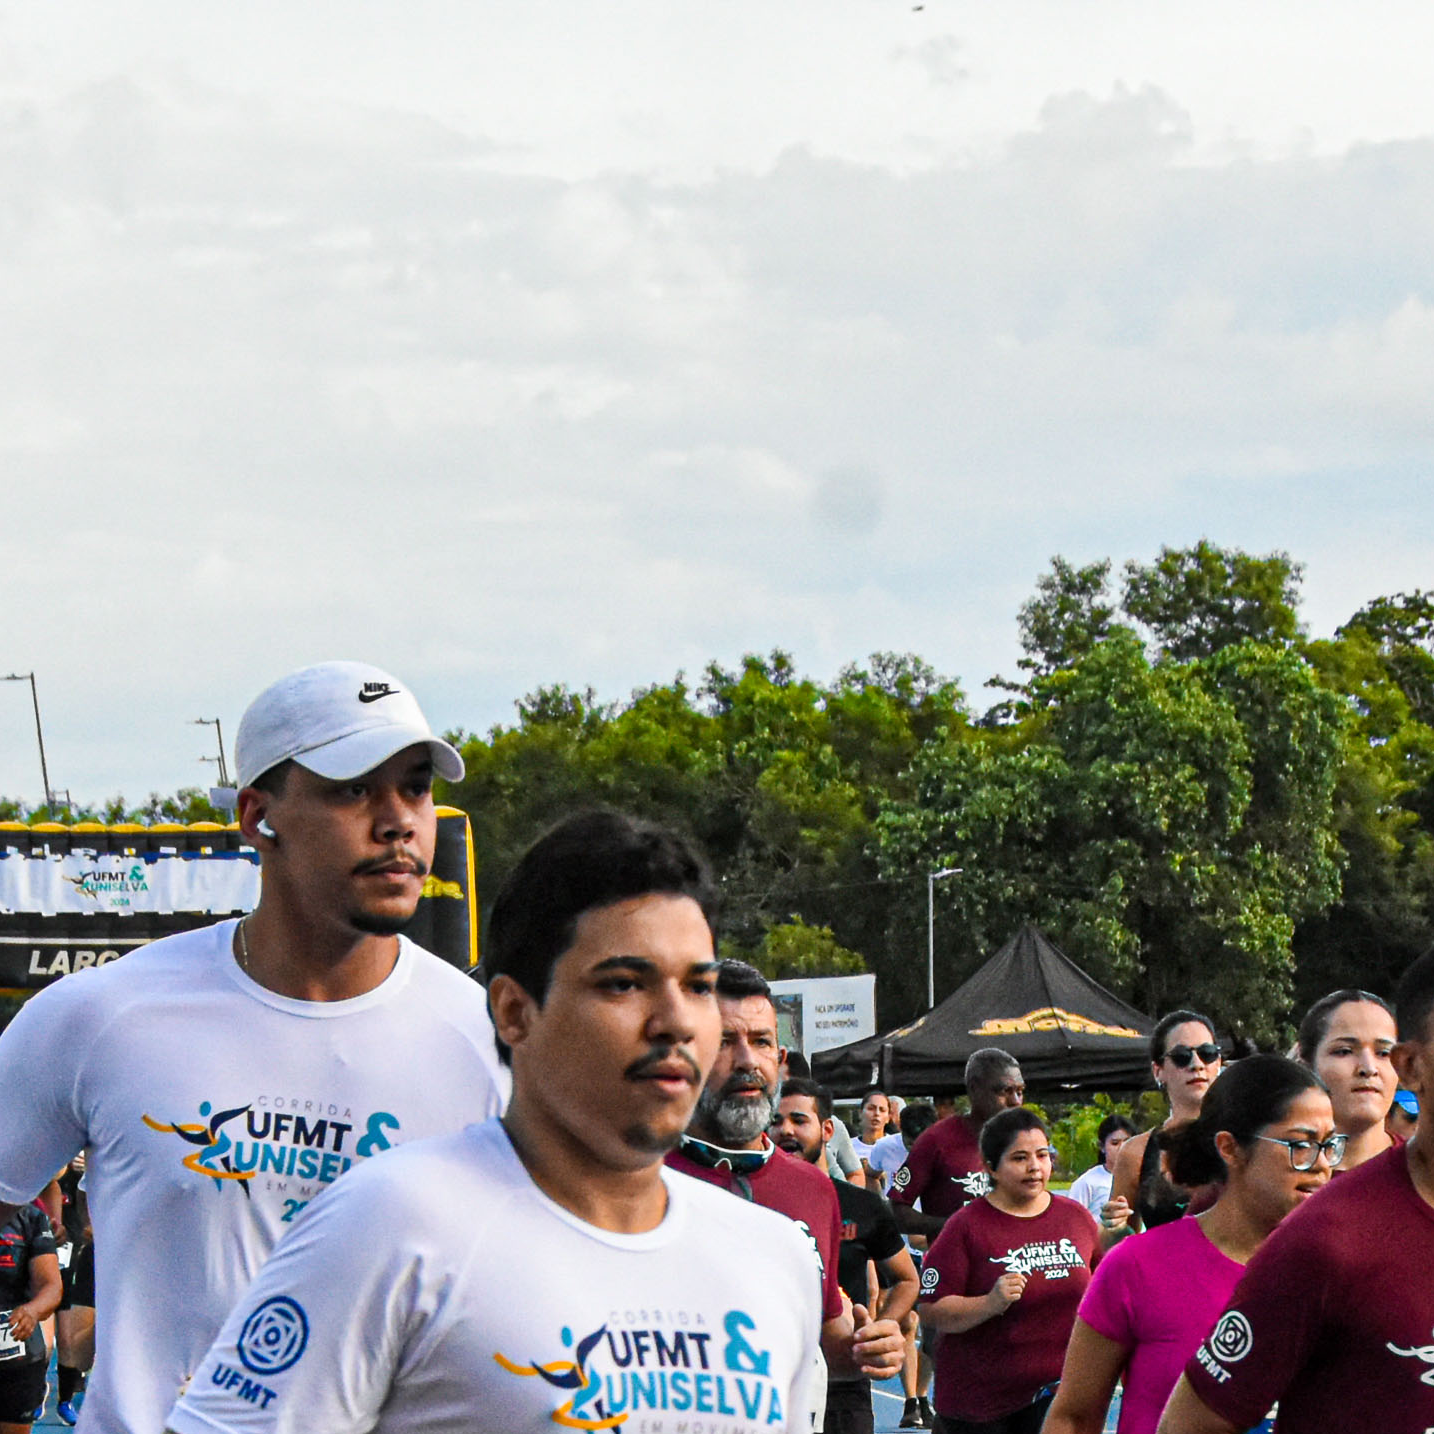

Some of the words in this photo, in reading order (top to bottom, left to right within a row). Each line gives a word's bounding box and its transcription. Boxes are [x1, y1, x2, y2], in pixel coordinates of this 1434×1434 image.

[364, 682, 389, 692] NIKE
[93, 872, 126, 880] UFMT
[129, 865, 144, 880] &
[91, 882, 148, 891] UNISELVA
[258, 1095, 352, 1118] CORRIDA
[246, 1110, 352, 1152] UFMT
[356, 1111, 400, 1157] &
[1022, 1245, 1057, 1257] UFMT
[1059, 1238, 1076, 1254] &
[1019, 1253, 1084, 1267] UNISELVA
[1044, 1269, 1069, 1279] 2024
[610, 1310, 706, 1326] CORRIDA
[607, 1330, 711, 1370] UFMT
[724, 1310, 771, 1377] &
[1196, 1345, 1232, 1383] UFMT
[212, 1363, 278, 1409] UFMT
[606, 1371, 783, 1425] UNISELVA
[639, 1420, 664, 1434] EM
